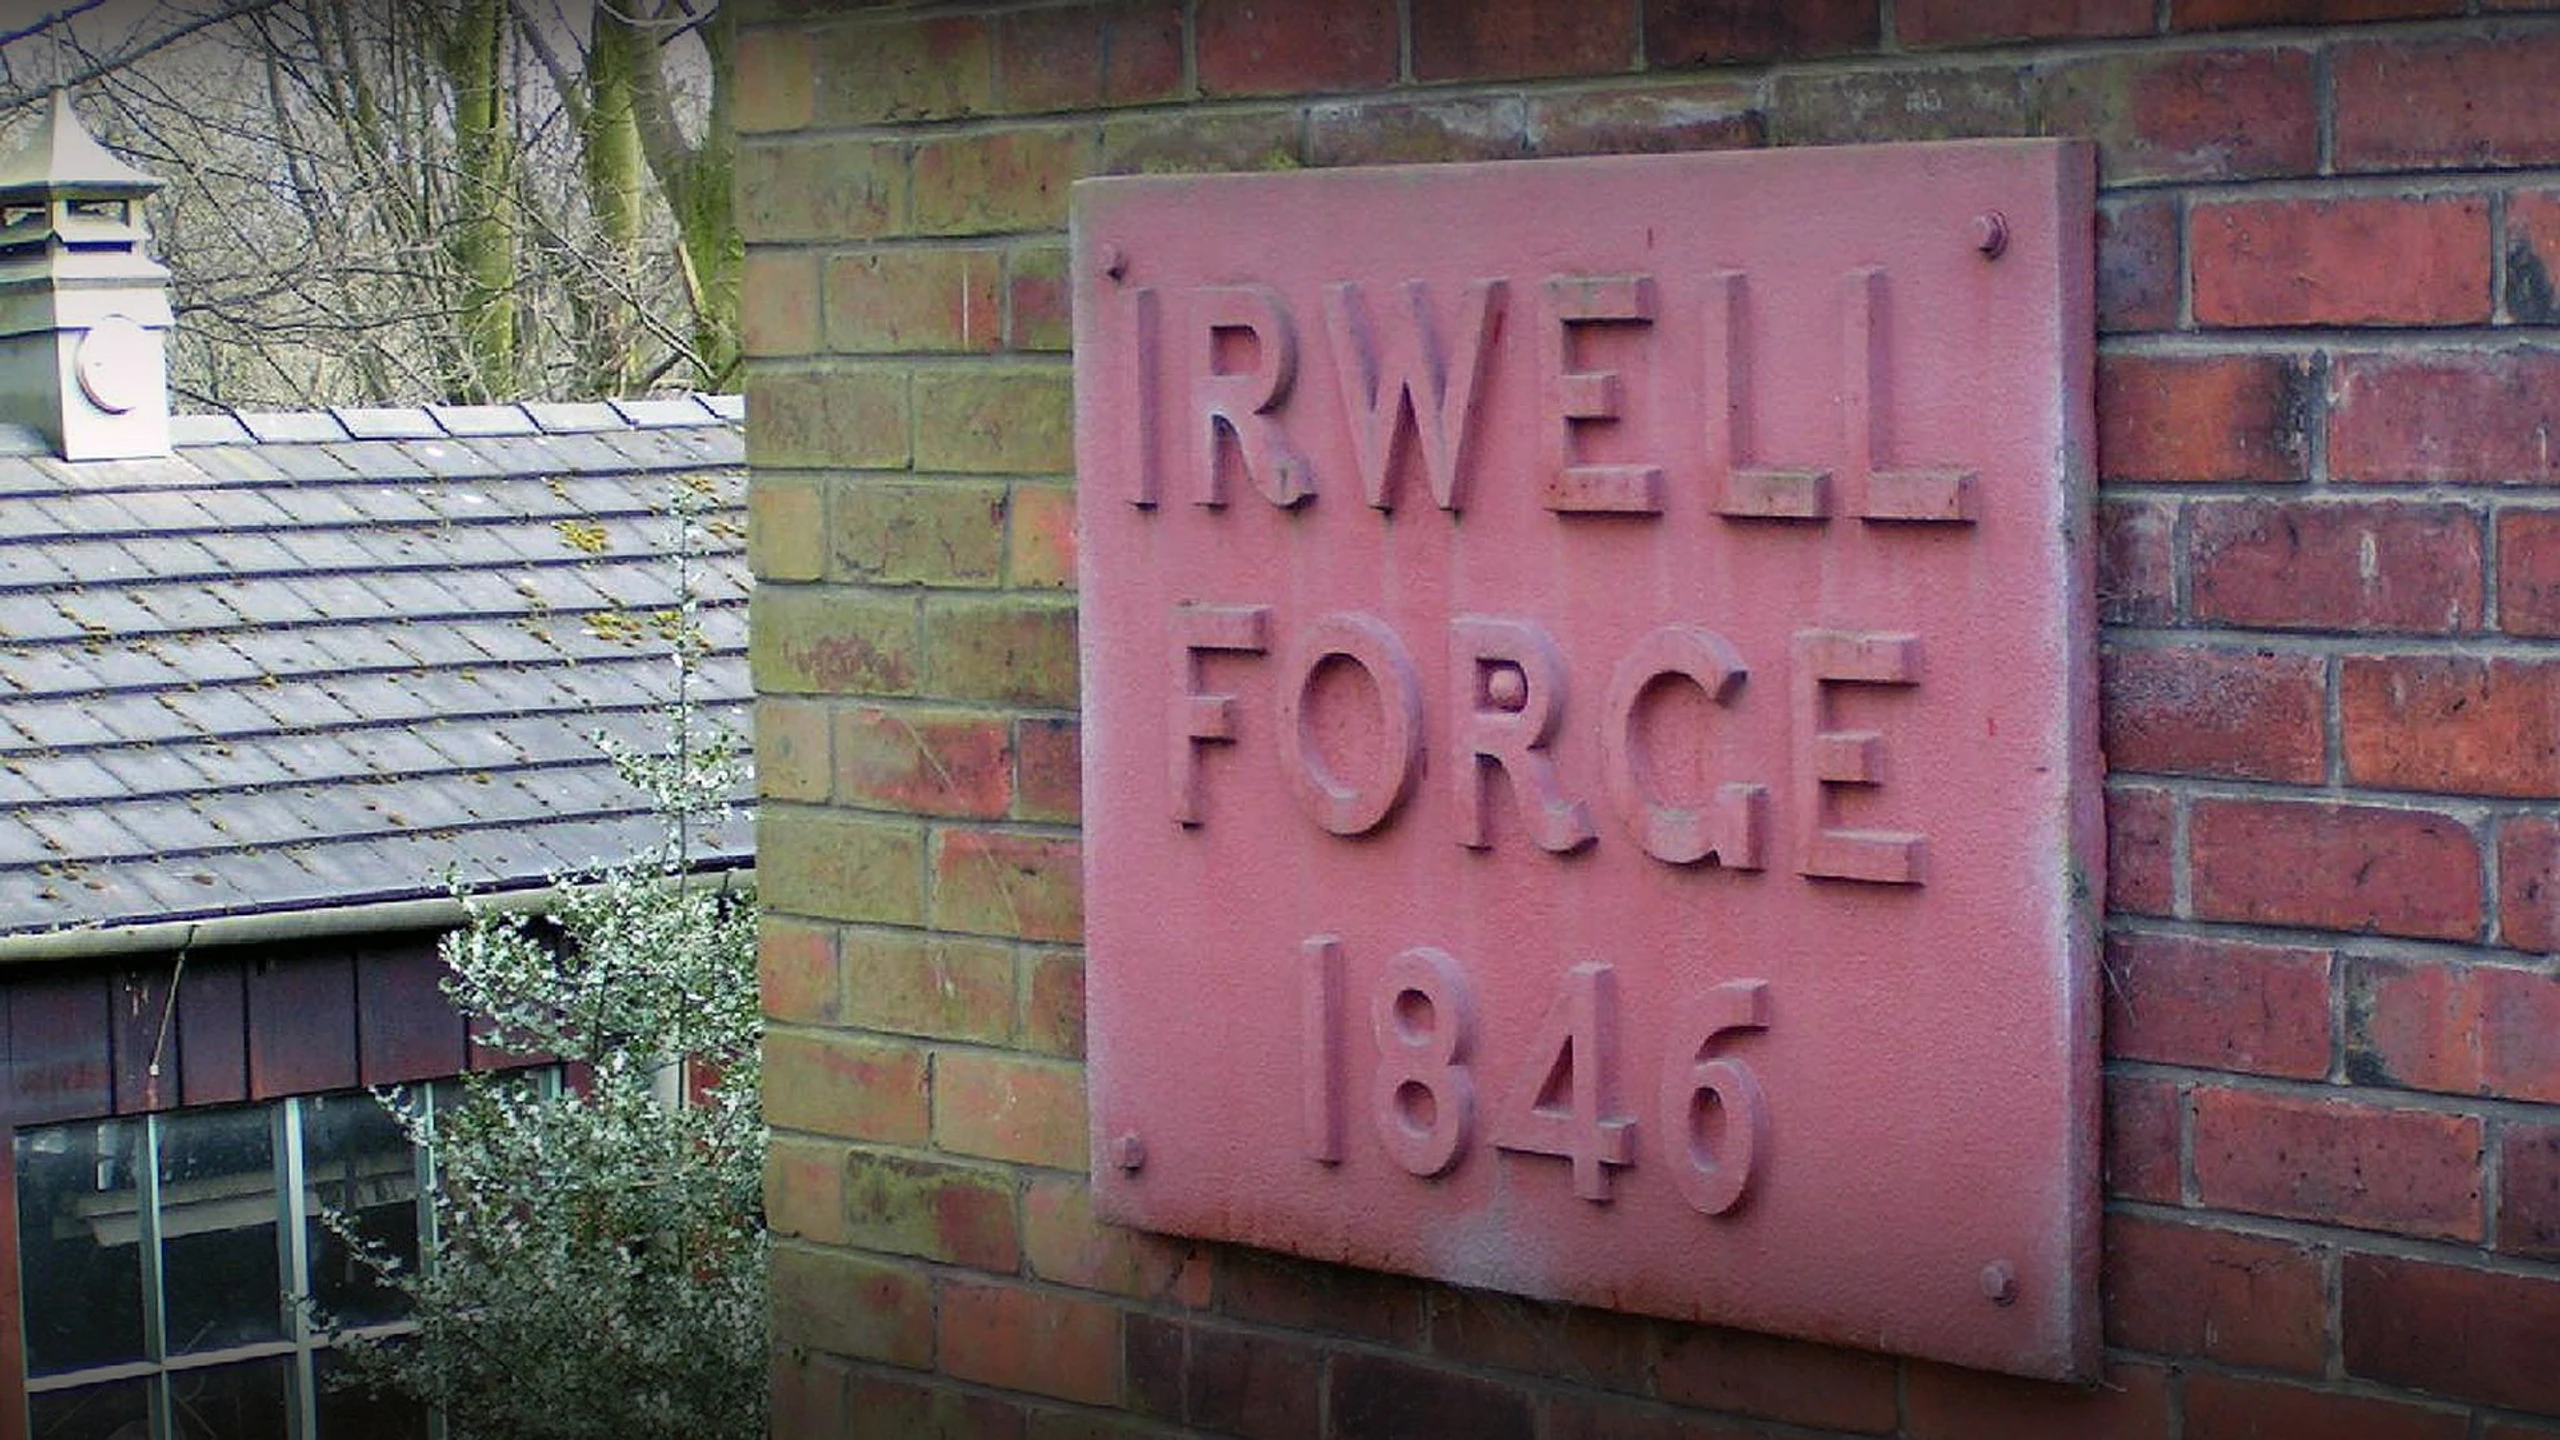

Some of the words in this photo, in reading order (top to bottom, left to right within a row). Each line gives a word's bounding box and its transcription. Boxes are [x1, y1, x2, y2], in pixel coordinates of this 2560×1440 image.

[1125, 268, 1979, 524] IRWELL
[1167, 602, 1926, 888] FORGE
[1299, 934, 1770, 1217] 1846
